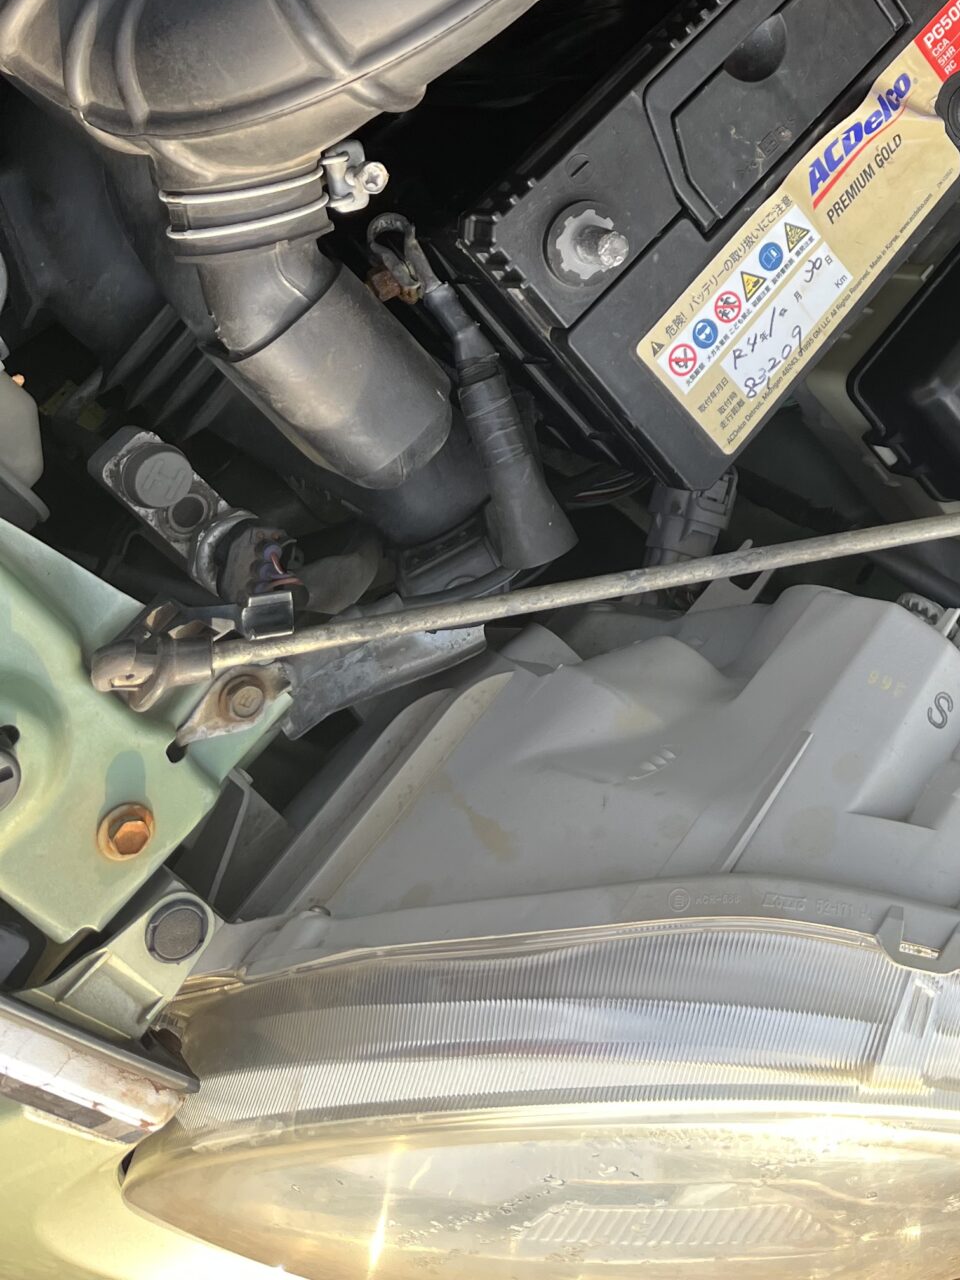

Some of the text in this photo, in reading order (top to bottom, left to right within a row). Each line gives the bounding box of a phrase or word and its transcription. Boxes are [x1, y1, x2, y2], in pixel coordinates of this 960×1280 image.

[931, 36, 951, 58] CCA
[937, 44, 957, 67] 5HR
[943, 58, 958, 75] RC
[807, 72, 911, 197] ACDelco
[824, 131, 905, 225] PREMIUM GOLD
[689, 194, 793, 312] バッテリーの取り扱いにご注意
[832, 272, 848, 289] Km
[696, 375, 730, 414] 取付年月日
[926, 690, 954, 730] S
